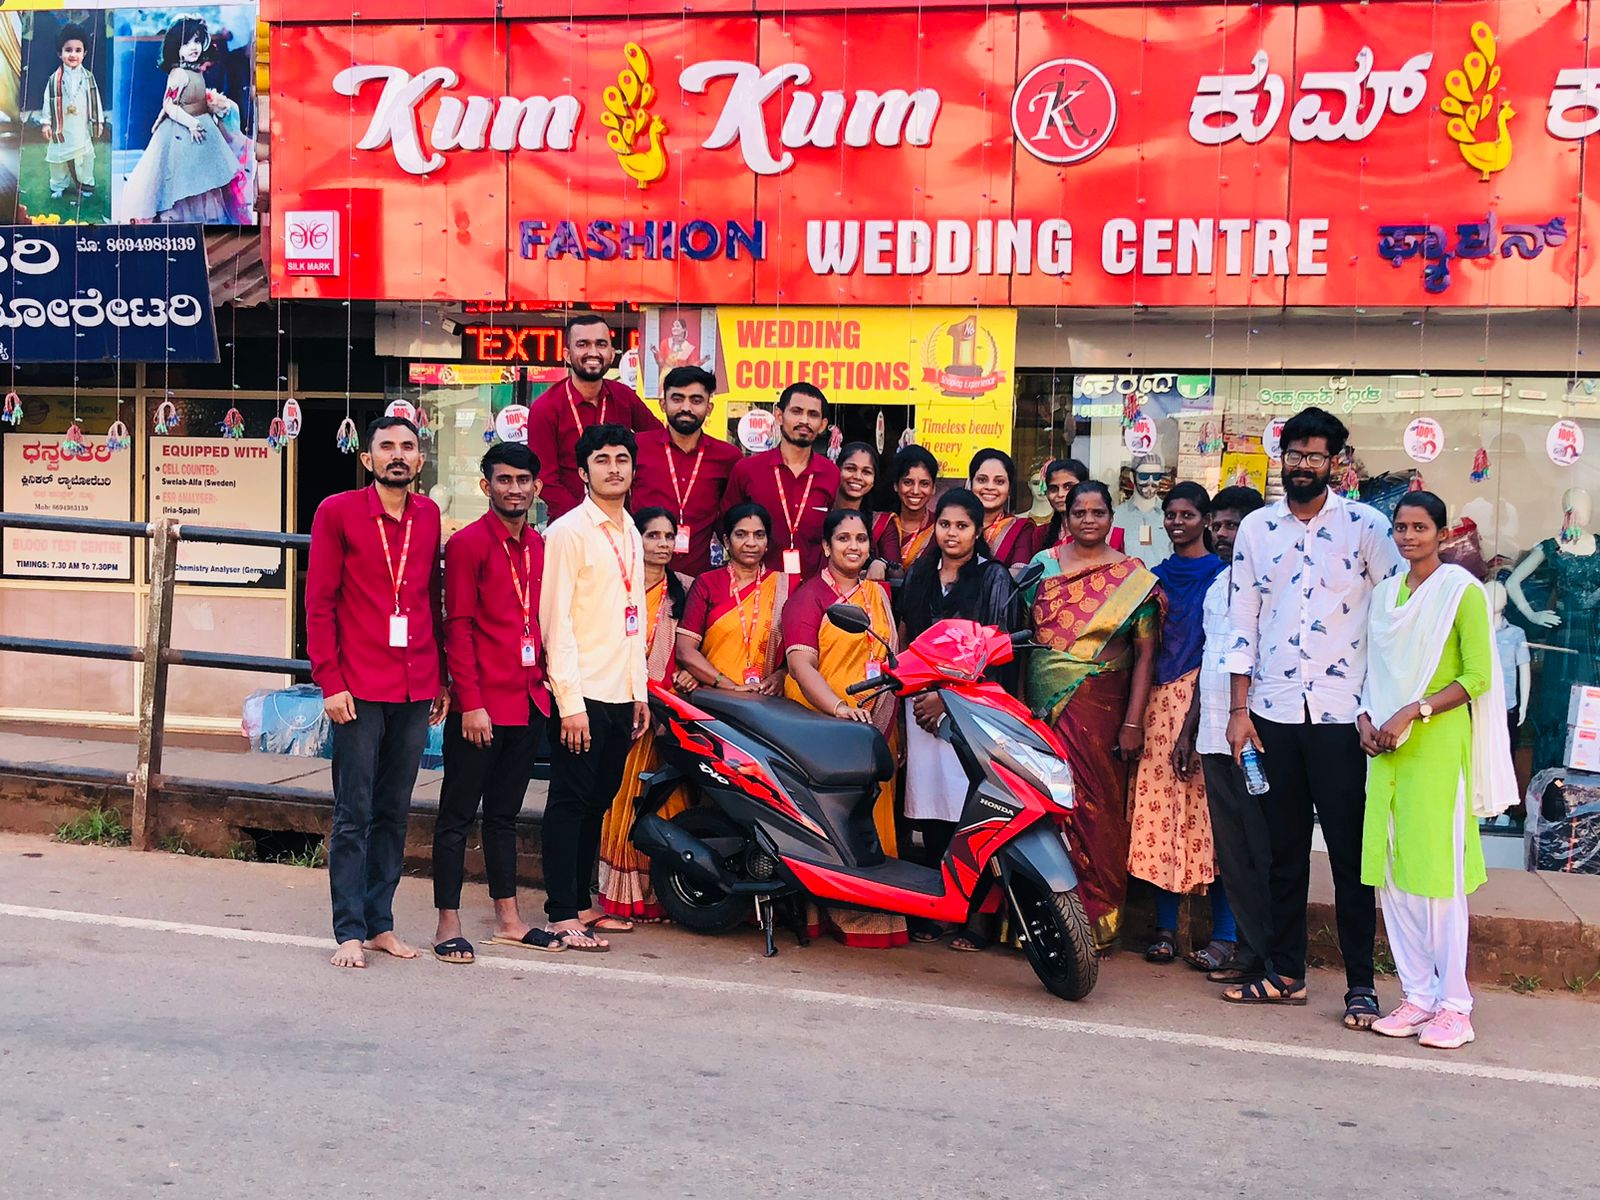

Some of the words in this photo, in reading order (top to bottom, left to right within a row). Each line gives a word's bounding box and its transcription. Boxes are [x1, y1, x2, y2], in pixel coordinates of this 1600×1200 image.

[1188, 46, 1434, 145] ಕುಮ್
[332, 65, 583, 176] Kum
[678, 60, 942, 176] Kum
[106, 237, 197, 252] 8694983139
[518, 217, 766, 264] FASHION
[805, 218, 1074, 278] WEDDING
[1101, 217, 1330, 277] CENTRE
[287, 262, 305, 271] SILK
[307, 262, 331, 271] MARK
[736, 320, 861, 349] WEDDING
[735, 360, 911, 391] COLLECTIONS
[922, 418, 966, 434] Timeless
[968, 420, 1004, 439] beauty
[162, 445, 230, 458] EQUIPPED
[234, 446, 268, 459] WITH
[934, 442, 962, 457] every
[162, 463, 179, 475] CELL
[204, 479, 236, 488] (Sweden)
[12, 538, 49, 551] BLOOD
[51, 539, 77, 552] TEST
[80, 541, 124, 554] CENTRE
[17, 560, 50, 569] TIMINGS:
[51, 561, 67, 570] 7.30
[68, 562, 80, 570] AM
[92, 563, 119, 571] 7.30PM
[210, 565, 241, 574] Analyser
[979, 798, 1015, 817] HONDA
